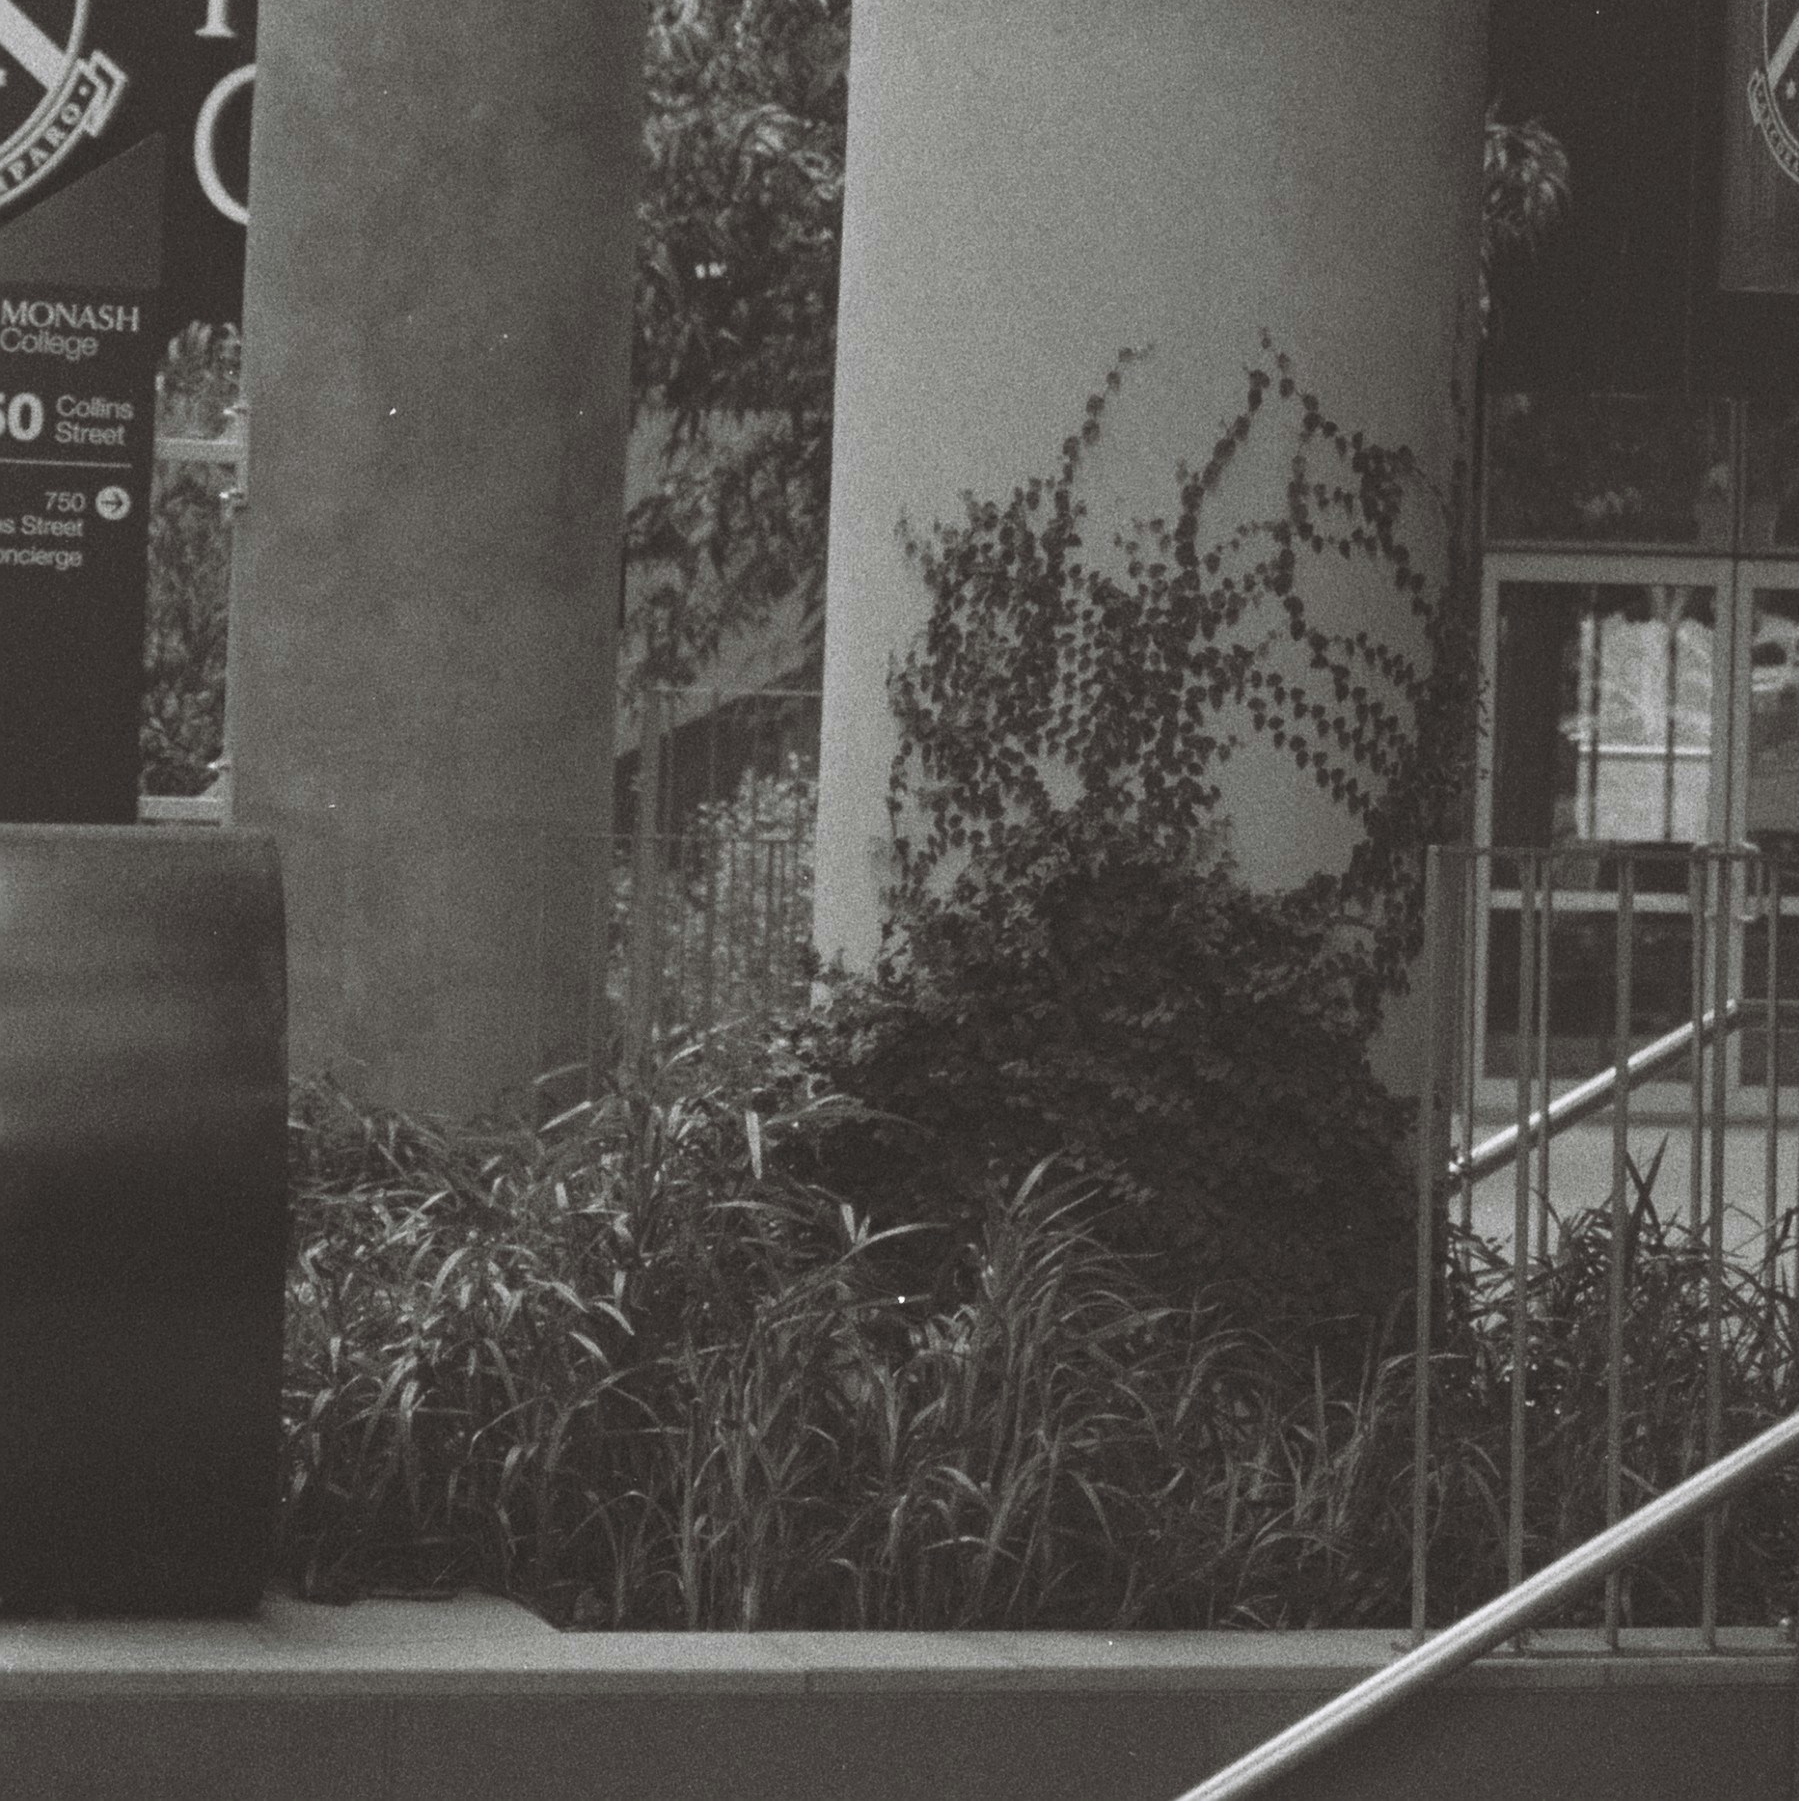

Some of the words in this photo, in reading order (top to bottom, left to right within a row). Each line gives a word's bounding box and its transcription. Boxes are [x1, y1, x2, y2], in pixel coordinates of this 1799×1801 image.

[0, 102, 82, 193] PARO
[1, 299, 140, 333] MONASH
[0, 326, 99, 362] College
[56, 395, 134, 420] Collins
[55, 420, 126, 446] Street
[45, 491, 86, 513] 750
[21, 514, 83, 537] Street
